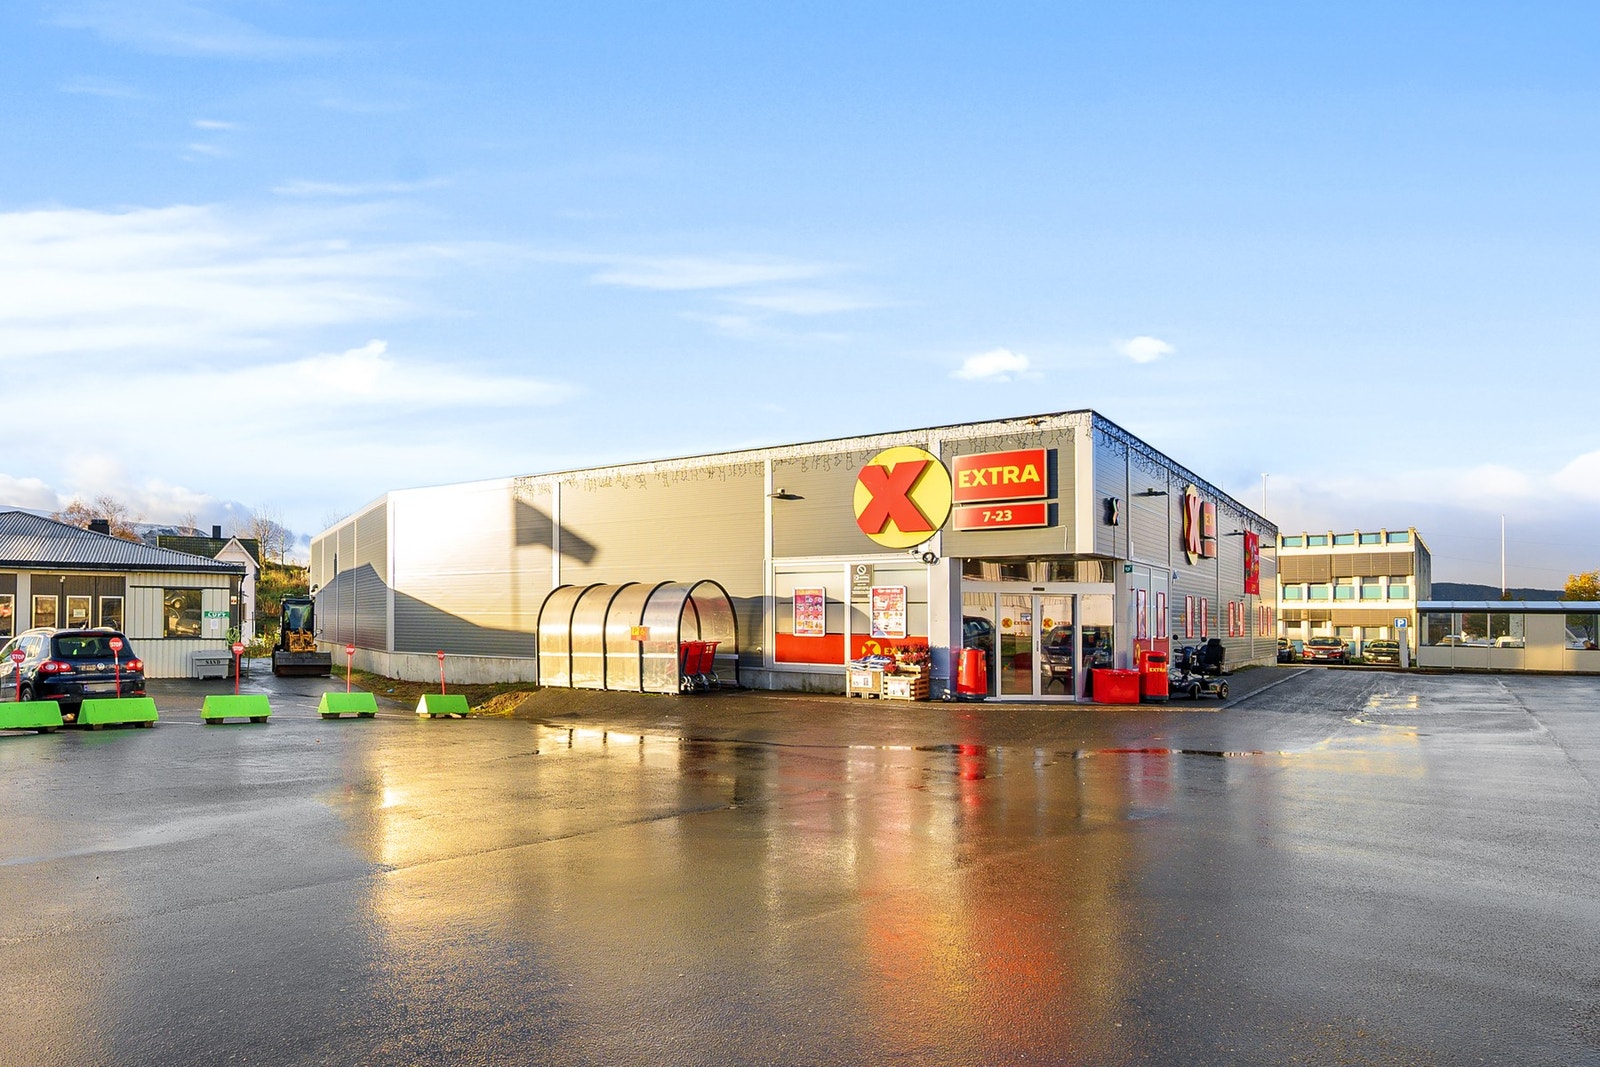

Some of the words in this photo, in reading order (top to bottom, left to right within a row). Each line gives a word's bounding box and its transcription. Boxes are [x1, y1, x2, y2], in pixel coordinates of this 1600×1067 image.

[958, 464, 1040, 488] EXTRA
[857, 460, 935, 534] X
[982, 510, 1012, 522] 7-23
